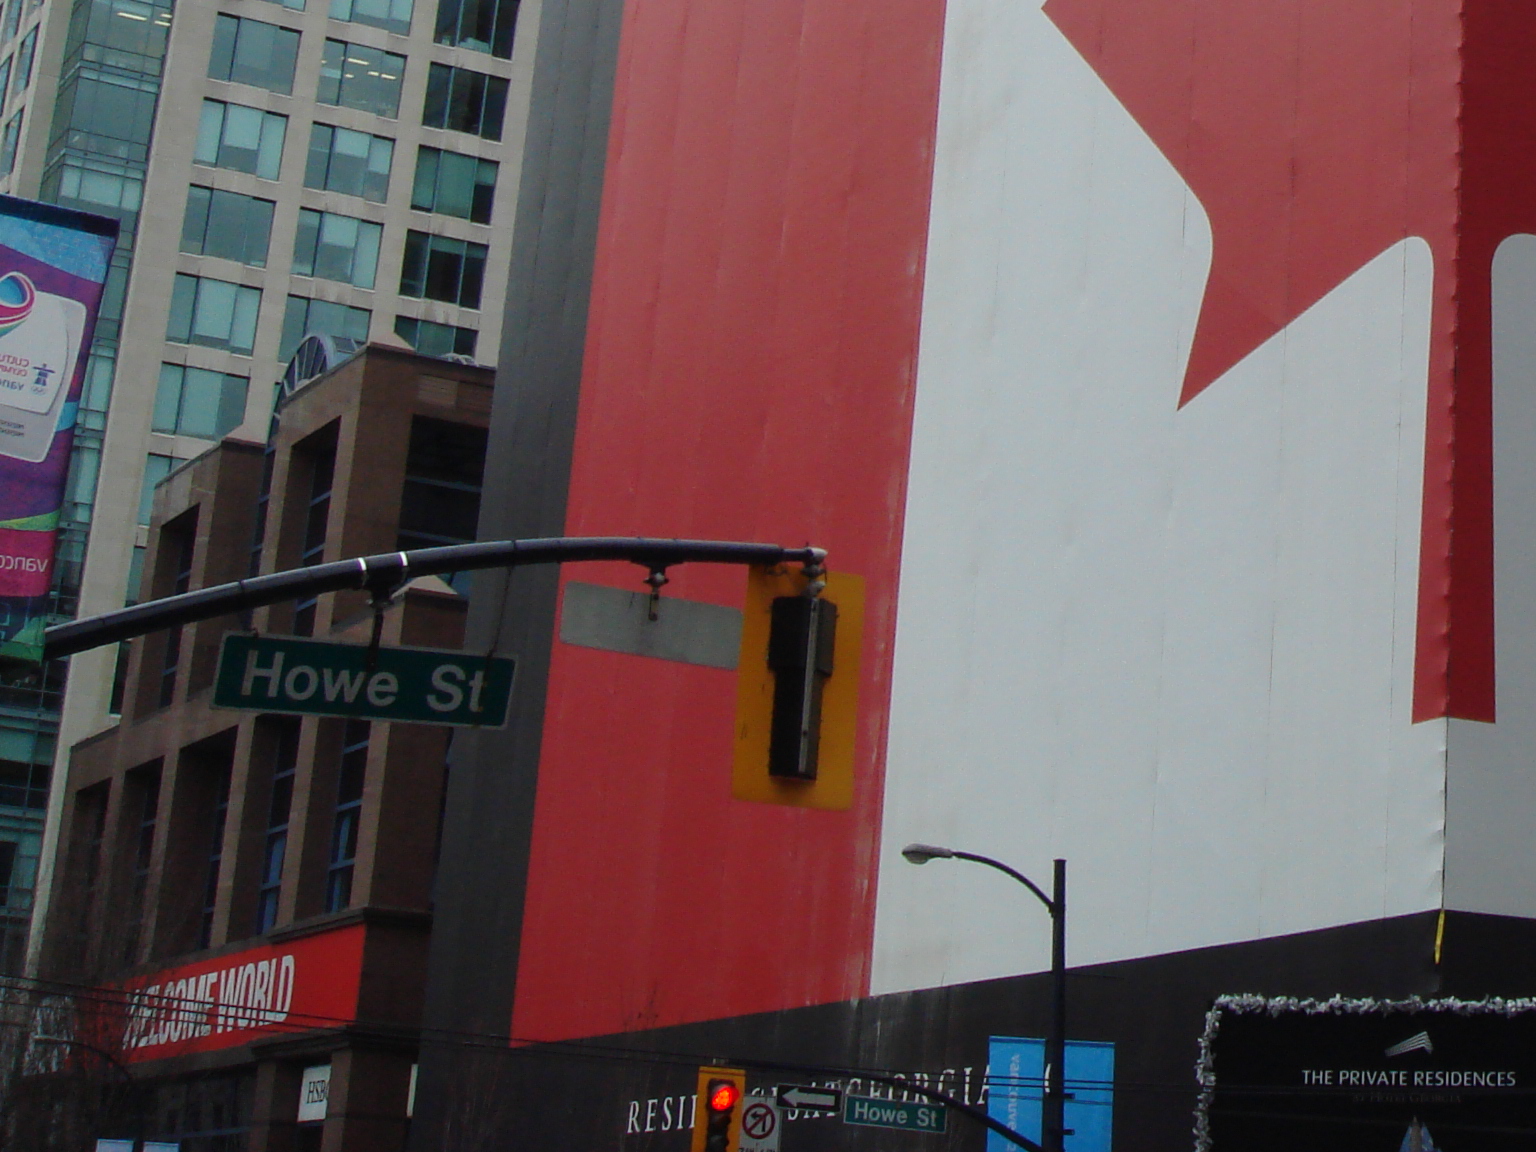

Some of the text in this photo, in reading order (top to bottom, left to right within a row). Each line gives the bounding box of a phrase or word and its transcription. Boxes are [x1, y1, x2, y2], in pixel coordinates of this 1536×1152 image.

[241, 649, 487, 712] Howe St
[122, 954, 295, 1051] WELCOME WORLD
[1302, 1069, 1516, 1087] THE PRIVATE RESIDENCES
[854, 1100, 938, 1128] Howe St
